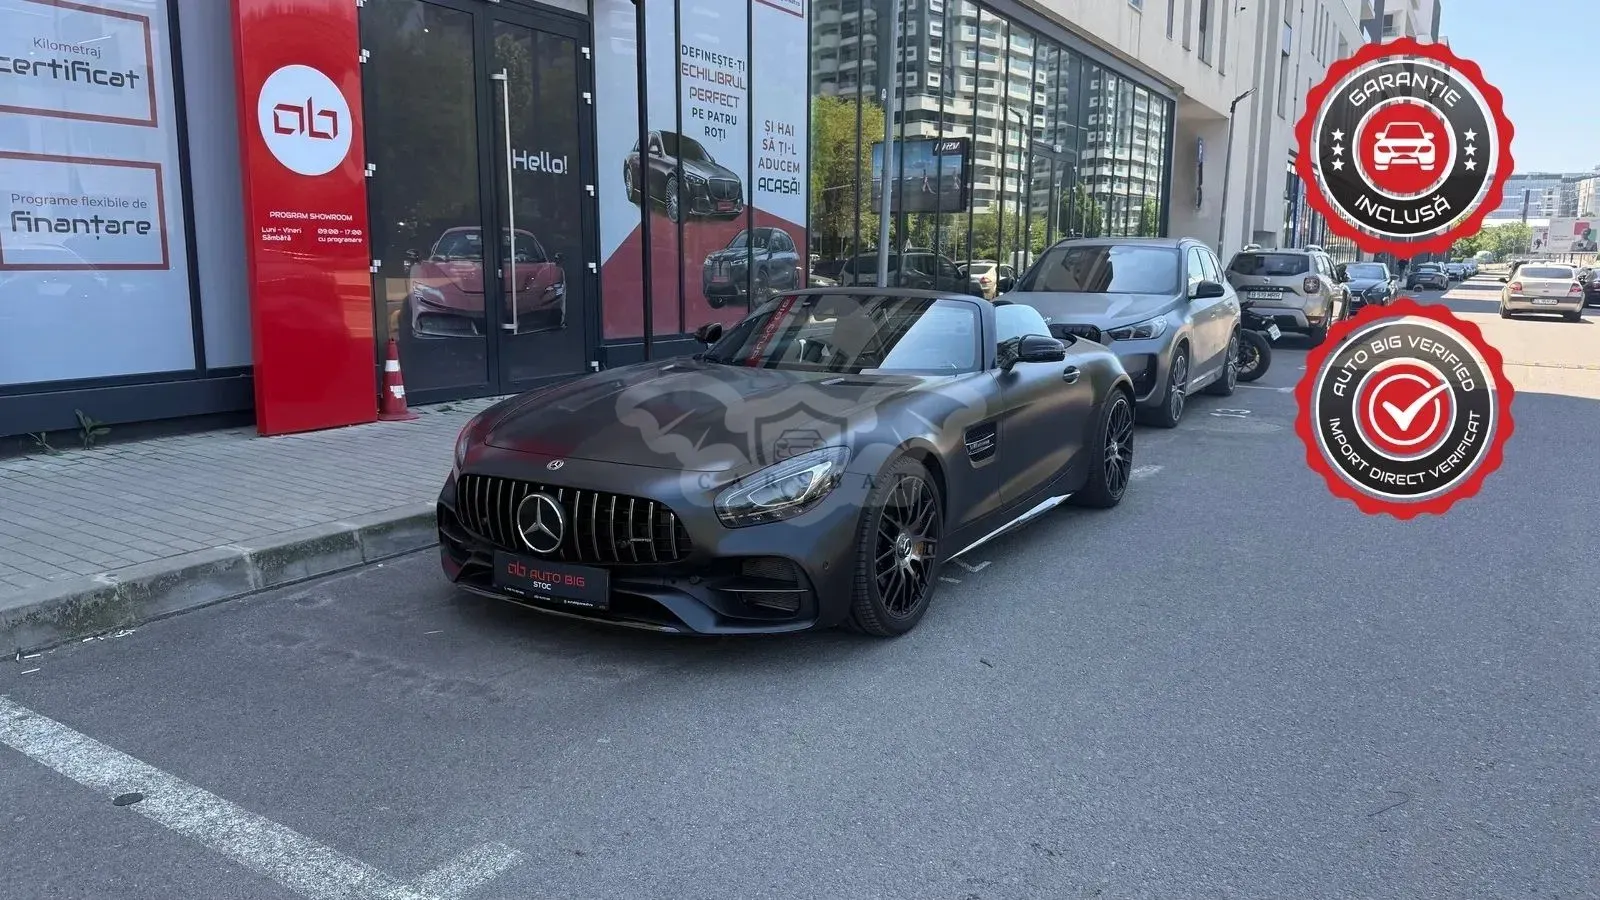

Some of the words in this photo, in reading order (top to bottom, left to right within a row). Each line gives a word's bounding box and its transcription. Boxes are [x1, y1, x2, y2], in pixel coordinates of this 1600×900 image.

[33, 37, 101, 59] Kilometraj
[681, 44, 745, 73] DEFINEȘTE-ȚI
[681, 62, 746, 91] ECHILIBRUL
[689, 86, 740, 108] PERFECT
[692, 107, 704, 119] PE
[707, 110, 737, 126] PATRU
[704, 125, 726, 142] ROȚI
[764, 120, 774, 136] ȘI
[777, 122, 794, 137] HAI
[762, 136, 775, 152] SĂ
[512, 148, 568, 175] Hello!
[758, 156, 800, 174] ADUCEM
[758, 176, 801, 195] ACASĂ!
[11, 193, 78, 207] Programe
[81, 195, 129, 208] flexibile
[132, 198, 147, 209] de
[10, 210, 152, 240] finanțare
[269, 211, 308, 220] PROGRAM
[309, 212, 353, 221] SHOWROOM
[529, 569, 561, 583] AUTO
[564, 575, 585, 587] BIG
[533, 580, 552, 591] STOC
